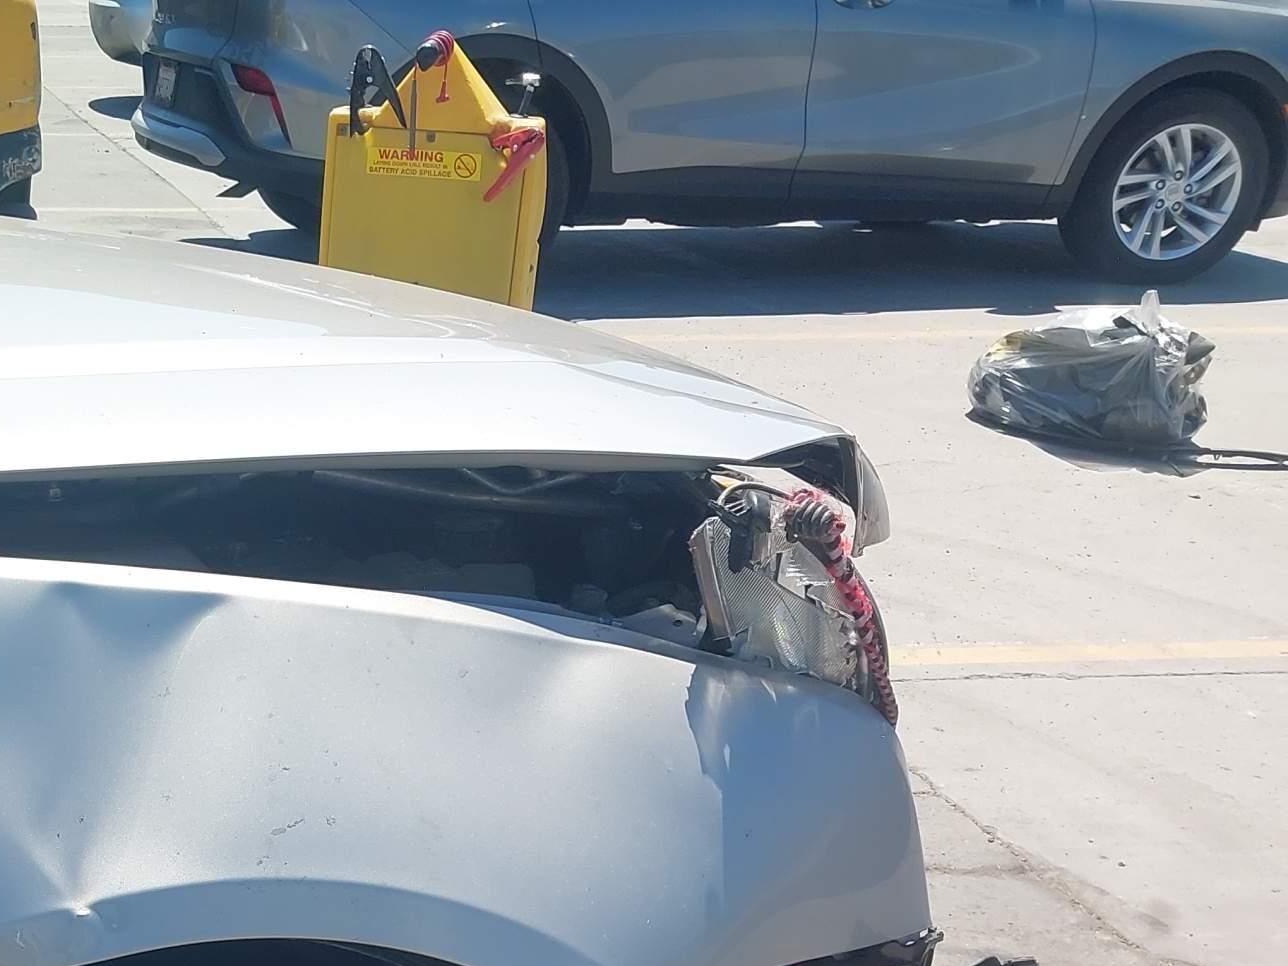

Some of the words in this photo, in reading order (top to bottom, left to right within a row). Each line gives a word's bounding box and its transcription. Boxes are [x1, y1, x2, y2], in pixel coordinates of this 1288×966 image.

[379, 148, 444, 163] WARNING
[369, 166, 399, 174] BATTERY
[419, 169, 452, 177] SPILLAGE
